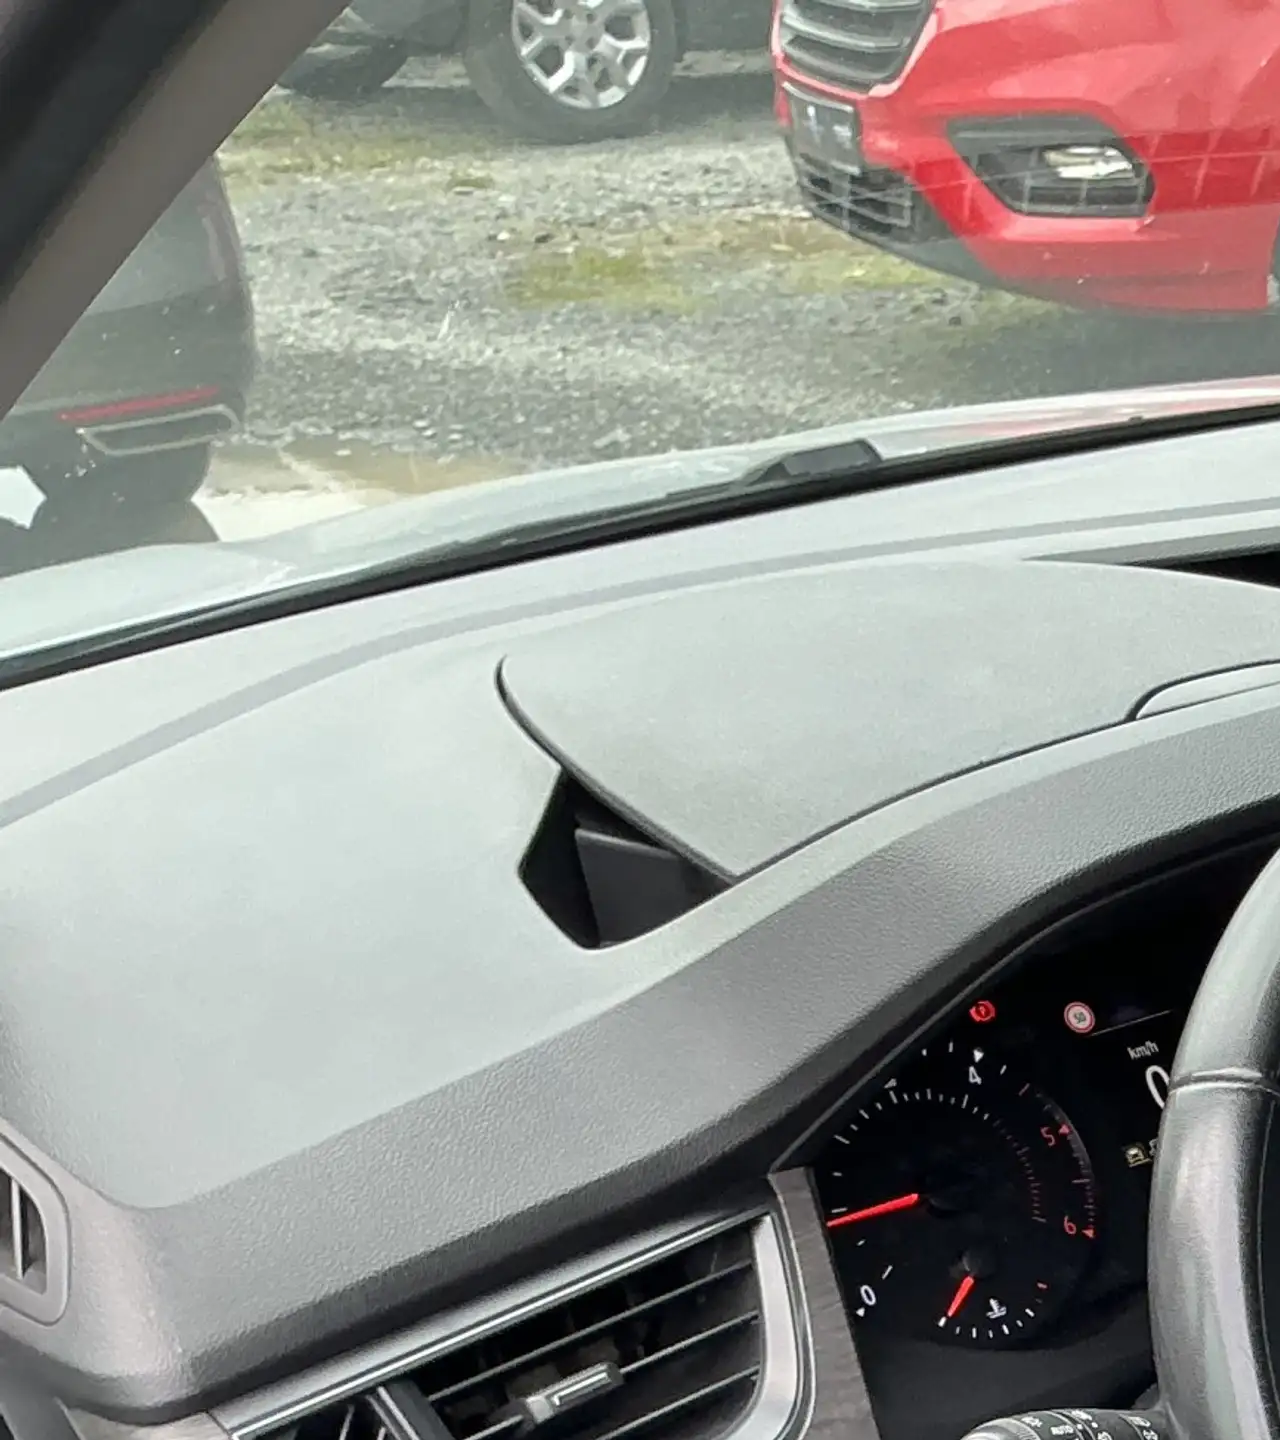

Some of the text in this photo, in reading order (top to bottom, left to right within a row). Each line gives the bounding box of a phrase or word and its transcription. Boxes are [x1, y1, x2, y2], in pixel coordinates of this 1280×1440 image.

[1127, 1040, 1160, 1060] km/h
[968, 1065, 982, 1086] 4
[1041, 1127, 1057, 1148] 5
[1062, 1216, 1077, 1235] 6
[860, 1284, 876, 1306] 0
